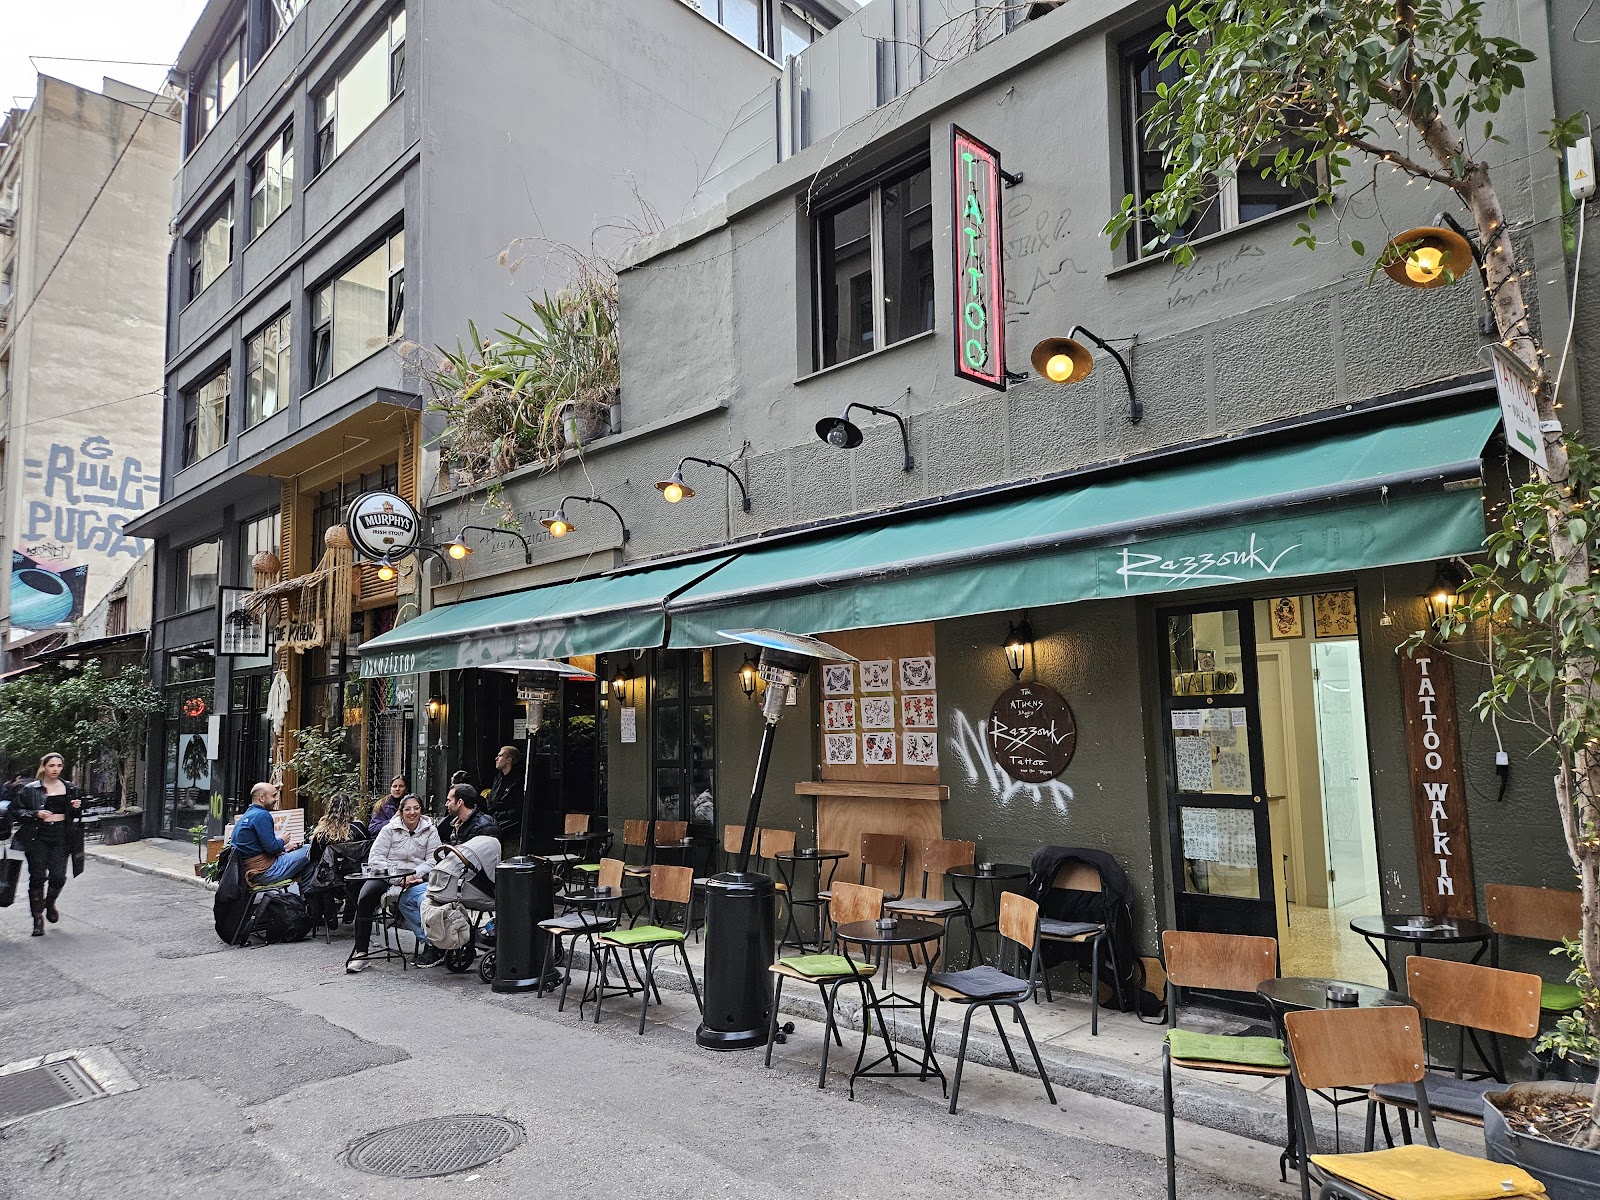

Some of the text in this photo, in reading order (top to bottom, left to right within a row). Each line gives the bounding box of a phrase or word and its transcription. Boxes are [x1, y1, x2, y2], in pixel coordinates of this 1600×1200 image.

[962, 152, 986, 368] TATTOO
[1494, 355, 1537, 413] TATTOO
[1175, 672, 1236, 693] TATTOO
[1008, 755, 1049, 766] Tattoo
[1415, 657, 1455, 896] TATTOO WALK IN
[211, 791, 223, 820] NO
